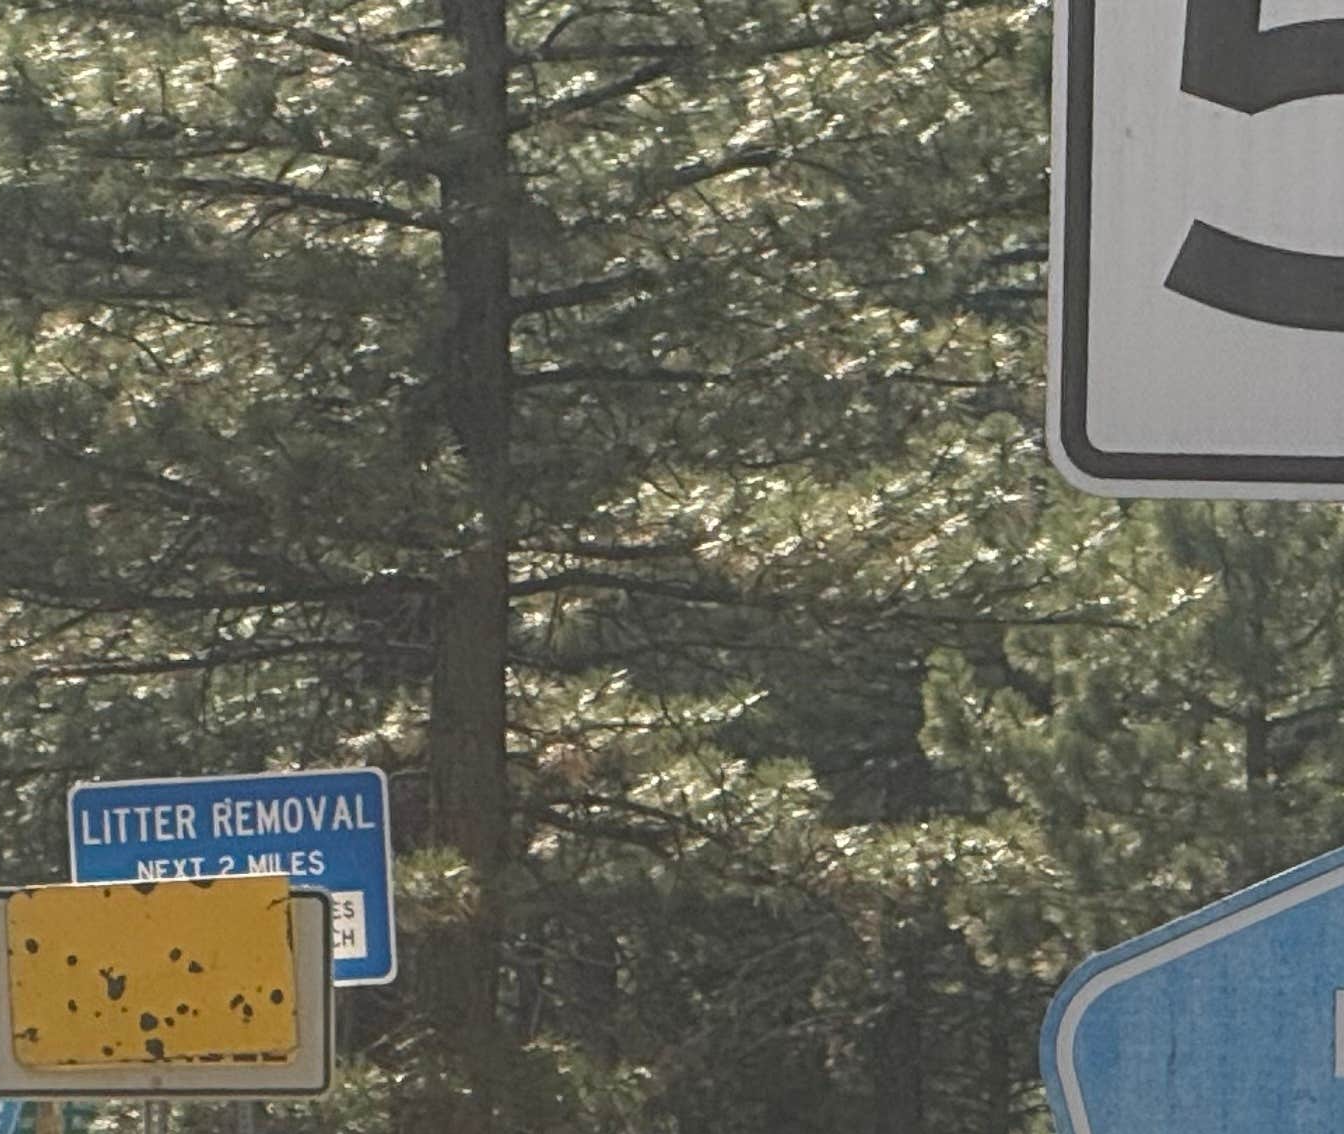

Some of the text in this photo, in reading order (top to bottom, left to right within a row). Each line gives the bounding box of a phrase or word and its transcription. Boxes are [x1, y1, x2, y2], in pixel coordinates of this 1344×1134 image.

[82, 794, 376, 845] LITTER REMOVAL
[137, 850, 325, 880] NEXT 2 MILES
